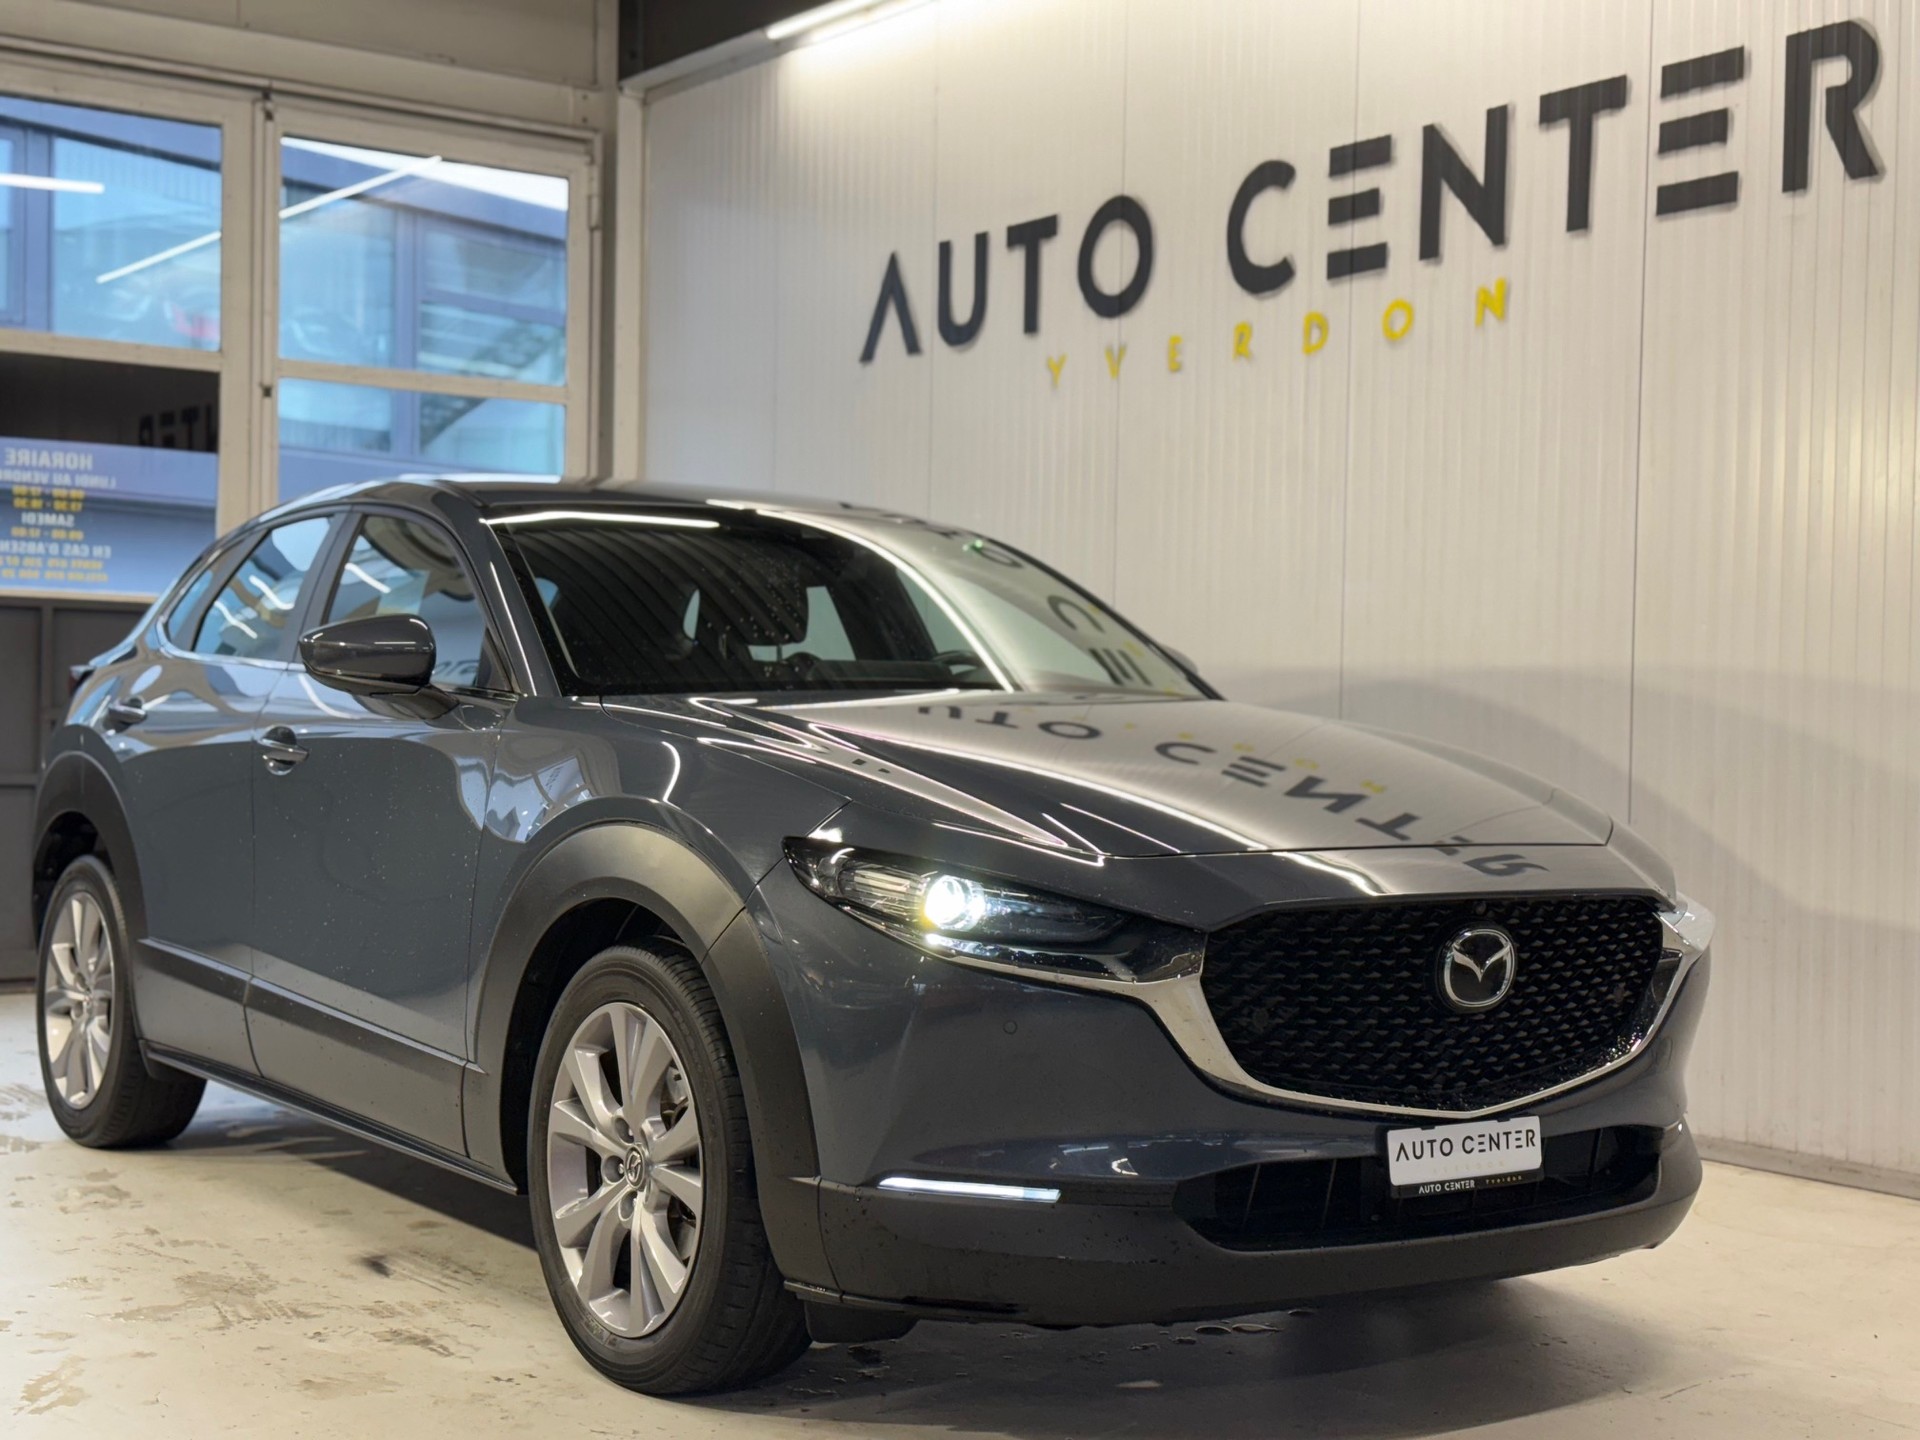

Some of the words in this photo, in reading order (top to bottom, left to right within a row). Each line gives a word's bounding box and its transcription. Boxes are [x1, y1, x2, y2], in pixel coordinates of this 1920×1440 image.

[860, 194, 1154, 365] AUTO
[1227, 19, 1885, 297] CENTER
[1048, 278, 1507, 387] YVERDON
[1395, 1137, 1453, 1162] AUTO
[1461, 1129, 1536, 1154] CENTER
[1418, 1183, 1442, 1195] AUTO
[1444, 1179, 1475, 1191] CENTER
